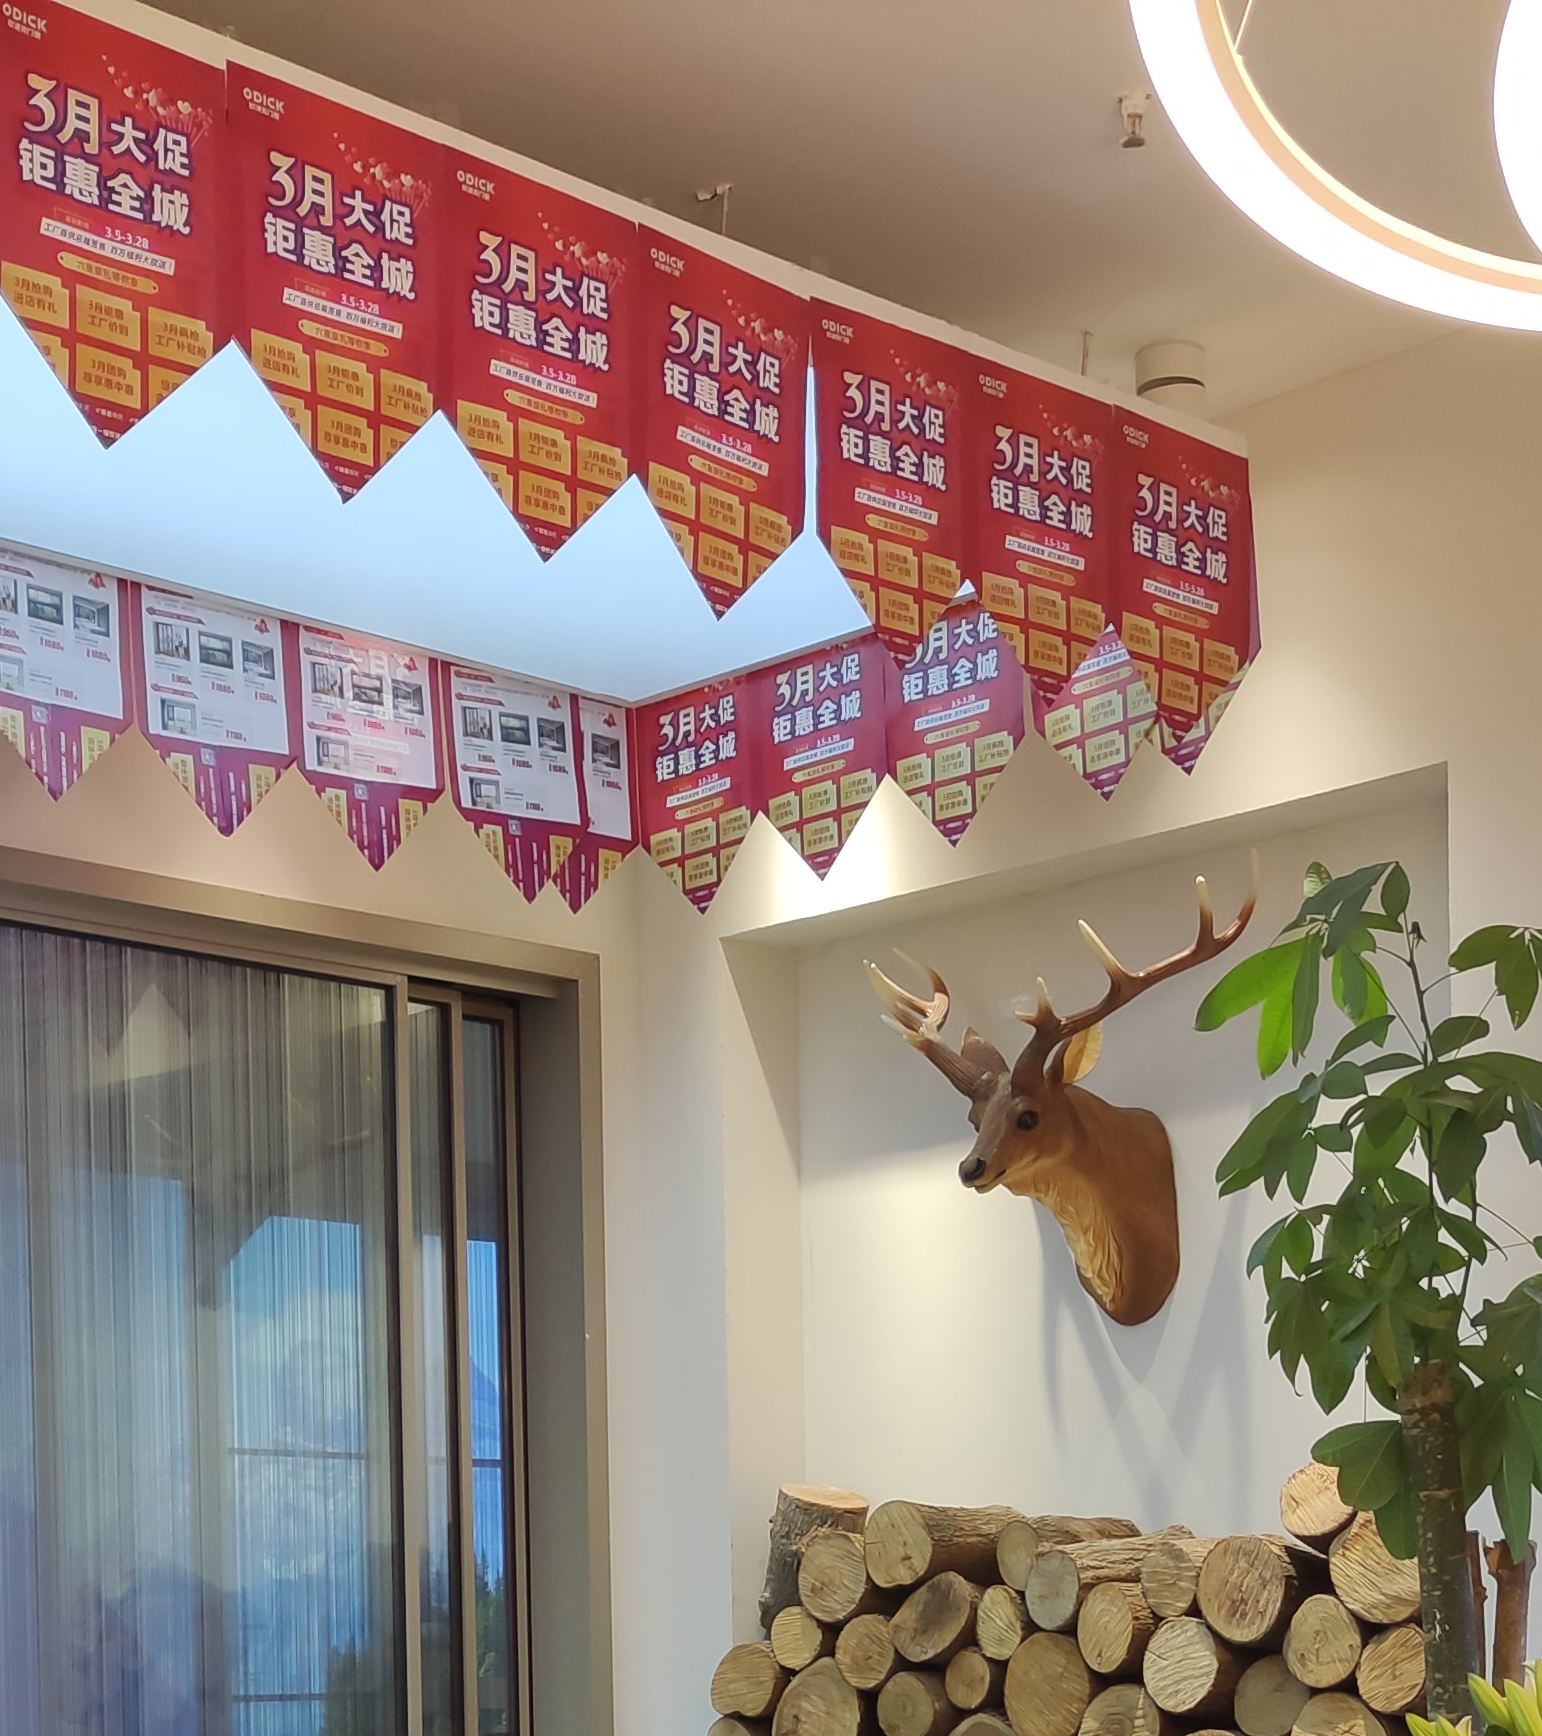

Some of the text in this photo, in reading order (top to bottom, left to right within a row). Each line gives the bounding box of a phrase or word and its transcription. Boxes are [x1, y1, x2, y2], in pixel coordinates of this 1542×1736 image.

[3, 3, 47, 34] ODICK
[23, 73, 190, 177] 3月大促
[19, 138, 190, 235] 钜惠全城
[266, 151, 413, 245] 3月大促
[105, 226, 149, 249] 3.5-3.28
[263, 213, 415, 300] 钜惠全城
[475, 231, 608, 319] 3月大促
[472, 289, 609, 371] 钜惠全城
[667, 305, 780, 393] 3月大促
[664, 359, 780, 441] 钜惠全城
[842, 371, 946, 443] 3月大促
[840, 425, 947, 490] 钜惠全城
[994, 425, 1092, 492] 3月大促
[992, 476, 1093, 537] 钜惠全城
[1135, 474, 1227, 541] 3月大促
[1132, 521, 1227, 583] 钜惠全城
[776, 653, 860, 711] 3月大促
[902, 649, 999, 703] 钜惠全城
[658, 694, 734, 751] 3月大促
[772, 689, 861, 744] 钜惠全城
[656, 731, 737, 782] 钜惠全城
